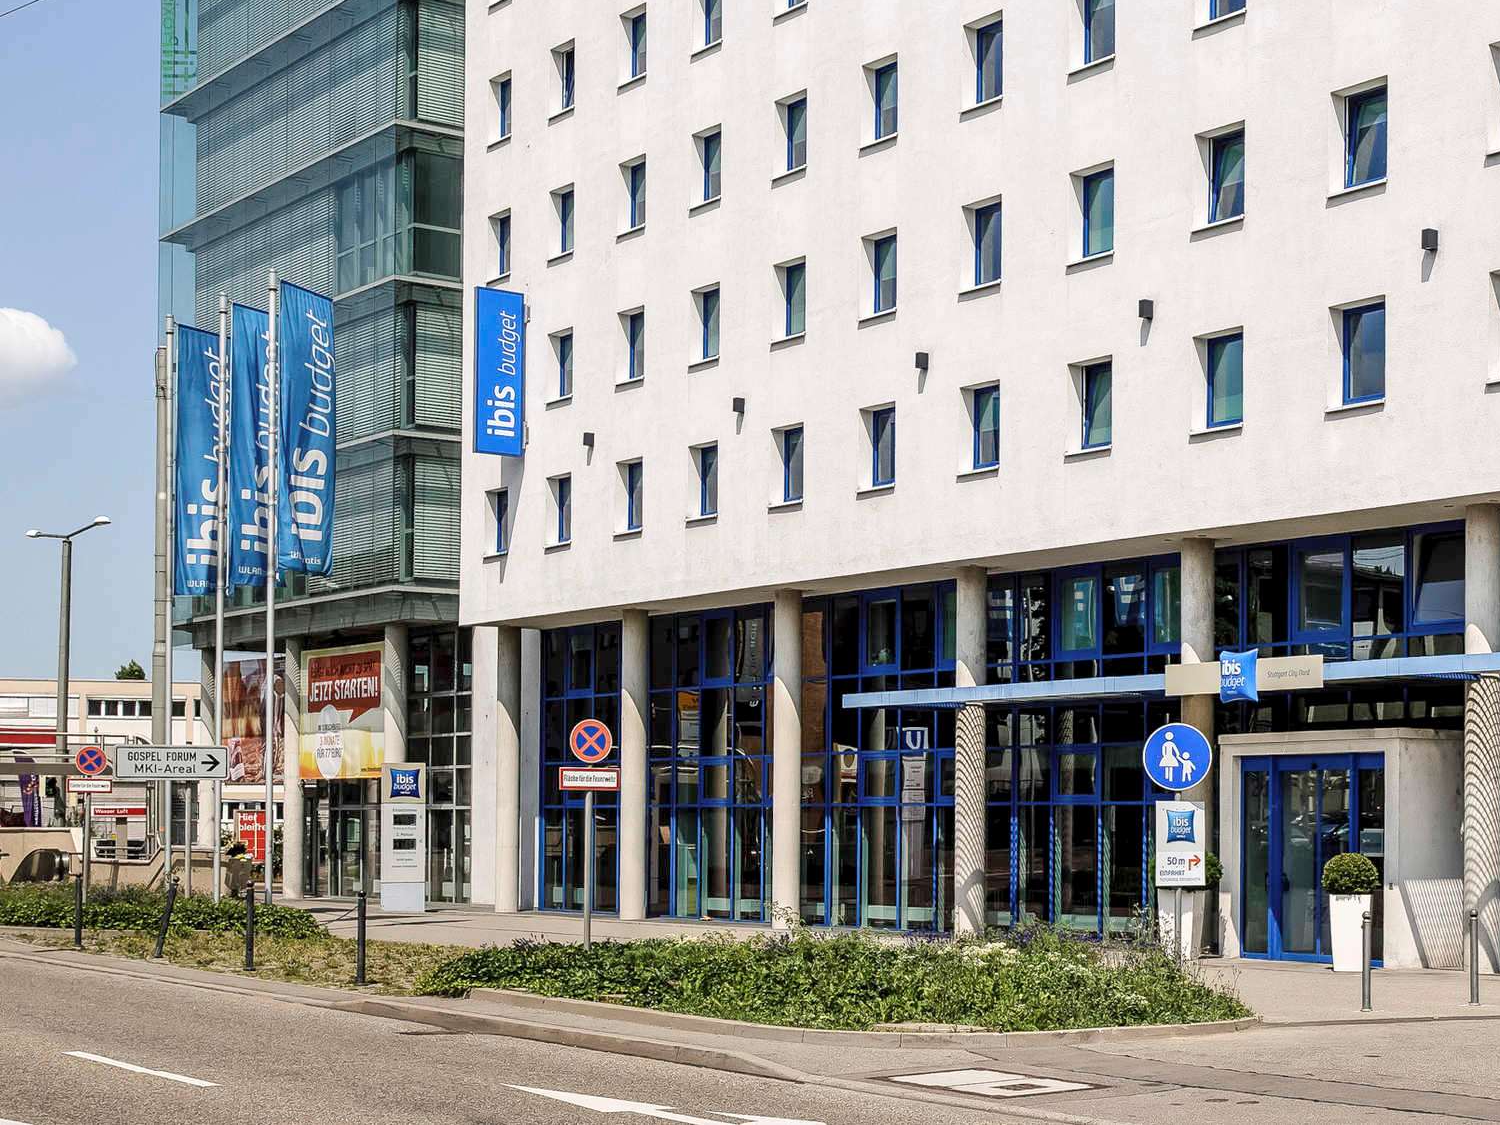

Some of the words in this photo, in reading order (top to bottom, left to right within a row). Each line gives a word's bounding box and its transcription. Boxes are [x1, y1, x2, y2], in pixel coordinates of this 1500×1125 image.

[497, 310, 520, 375] budget
[299, 309, 336, 437] budget
[486, 385, 516, 437] ibis
[291, 447, 328, 542] ibis
[1222, 659, 1241, 675] ibis
[309, 680, 333, 702] JETZT
[334, 675, 378, 700] STARTEN!
[127, 751, 161, 762] GOSPEL
[166, 751, 197, 762] FORUM
[134, 763, 196, 774] MKI-Areal
[396, 773, 414, 784] ibis
[393, 782, 417, 791] budget
[1172, 816, 1189, 827] ibis
[1170, 826, 1191, 835] budget
[1167, 856, 1177, 866] 50
